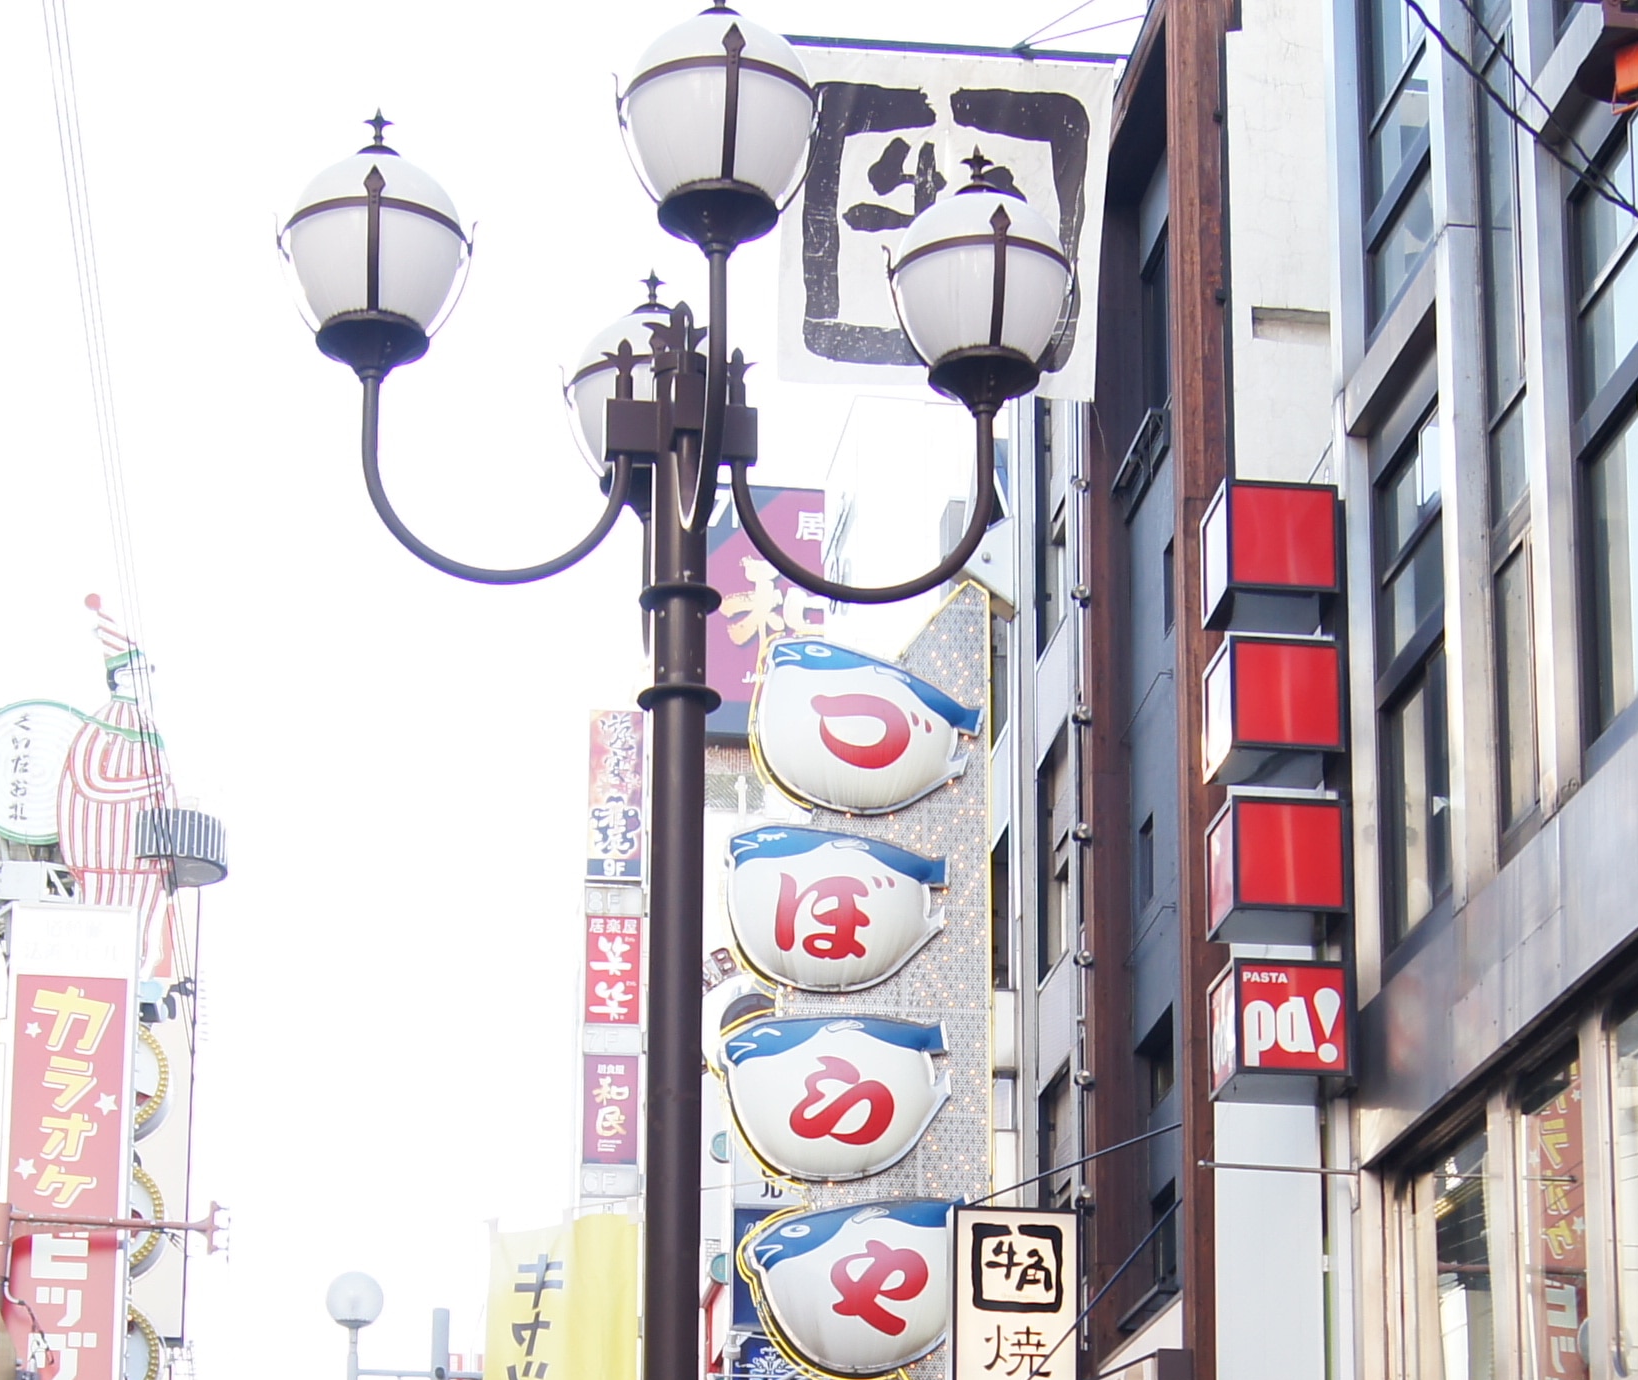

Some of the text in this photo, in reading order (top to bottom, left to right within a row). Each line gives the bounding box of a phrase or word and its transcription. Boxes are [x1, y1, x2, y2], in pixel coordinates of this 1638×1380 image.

[8, 712, 31, 822] くいだおれ
[602, 858, 626, 877] 9F
[1242, 971, 1288, 983] PASTA
[31, 984, 116, 1209] カラオケ
[983, 1239, 1055, 1294] 牛角
